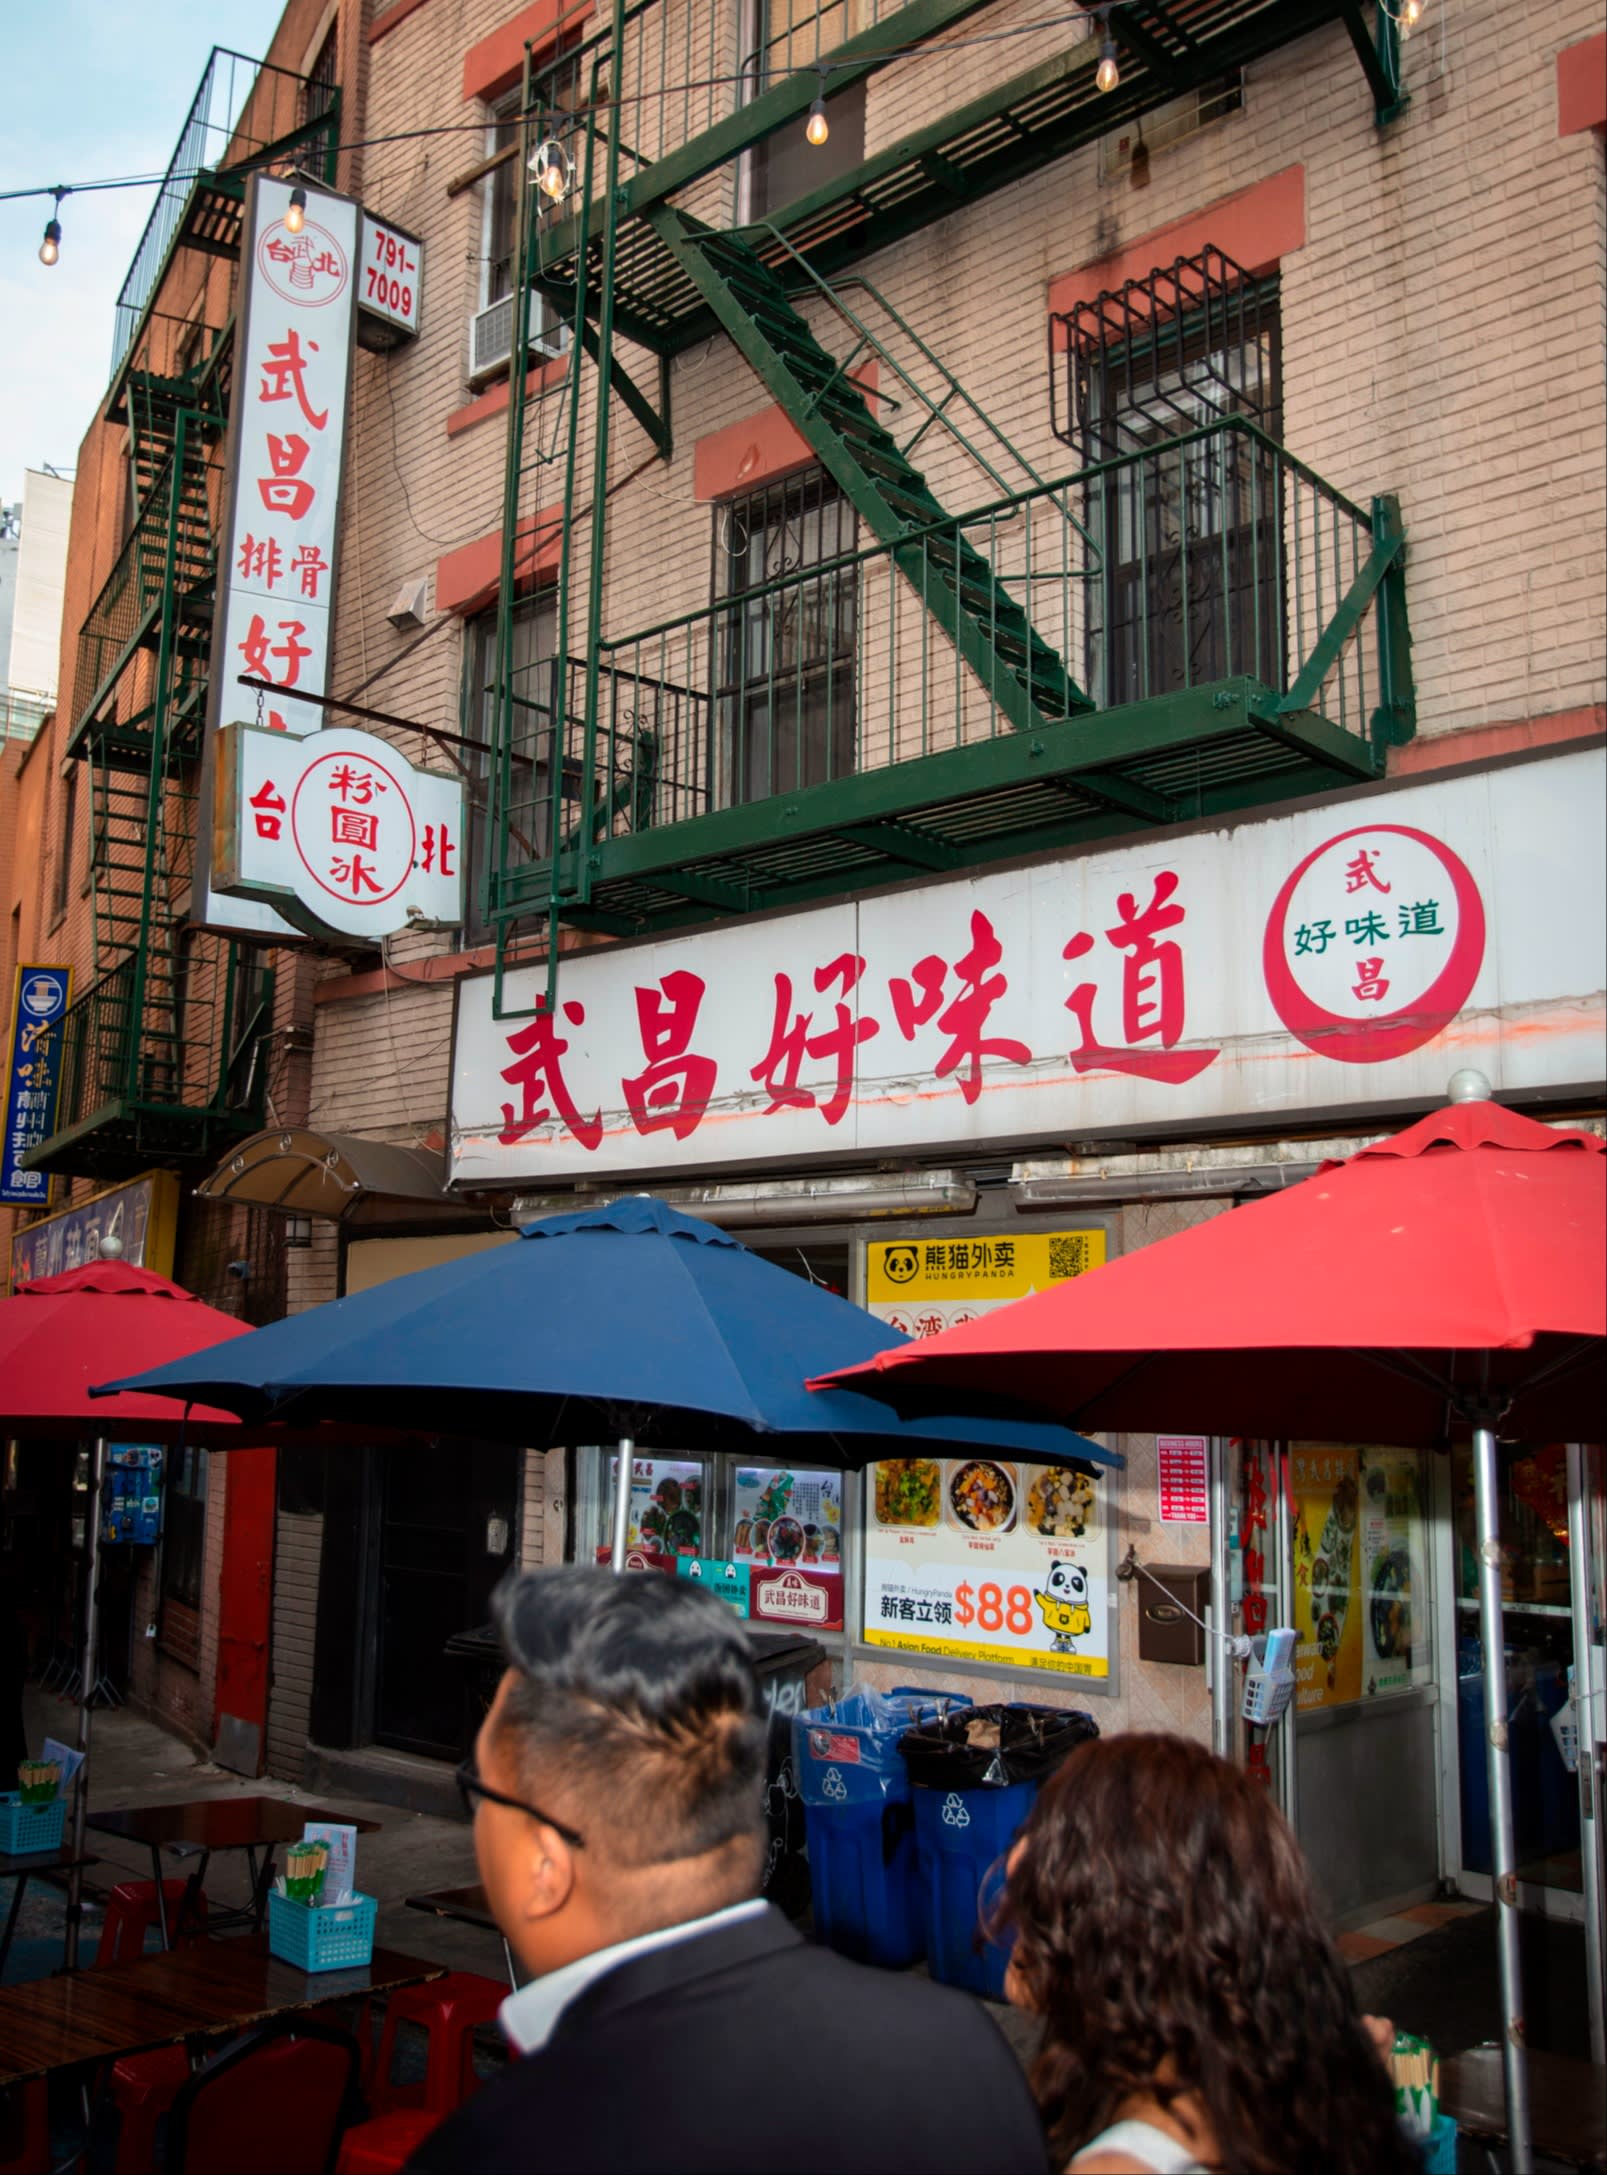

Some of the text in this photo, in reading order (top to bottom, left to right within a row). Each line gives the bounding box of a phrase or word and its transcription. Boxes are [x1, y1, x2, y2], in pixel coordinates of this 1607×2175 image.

[373, 230, 415, 273] 791-
[367, 267, 412, 317] 7009
[237, 533, 328, 599] 排骨
[329, 764, 388, 897] 粉圓冰
[1294, 898, 1445, 958] 好味道
[497, 870, 1222, 1152] 武昌好味道
[924, 1242, 1015, 1270] 熊猫外卖
[924, 1269, 1015, 1281] HUNGRYPANDA
[764, 1588, 821, 1611] 武昌好味道
[880, 1594, 953, 1626] 新客立领
[954, 1580, 1033, 1635] $88
[897, 1640, 919, 1652] Asian
[921, 1643, 942, 1655] Food
[943, 1646, 977, 1660] Delivery
[978, 1650, 1015, 1664] Platform
